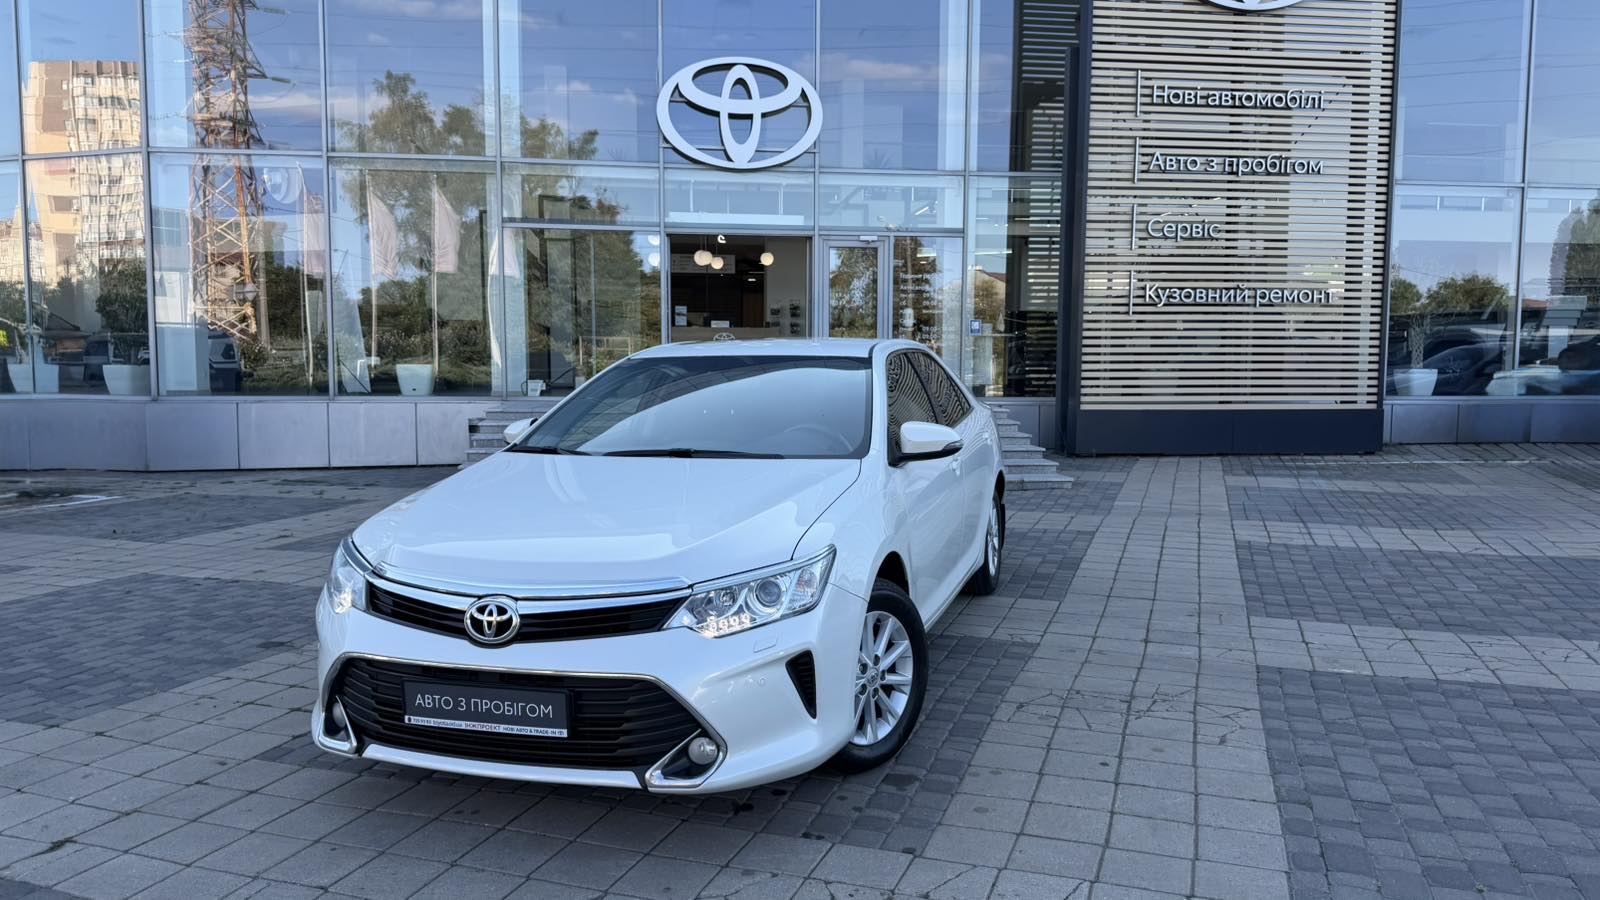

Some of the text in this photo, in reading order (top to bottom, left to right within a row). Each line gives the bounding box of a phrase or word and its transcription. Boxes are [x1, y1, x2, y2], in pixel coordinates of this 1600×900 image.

[1152, 84, 1325, 109] Нові автомобілі
[1149, 151, 1324, 177] Авто з пробігом
[1147, 218, 1222, 242] Сервіс
[1144, 283, 1335, 307] Кузовний ремонт
[415, 693, 553, 719] АВТО З ПРОБІГОМ
